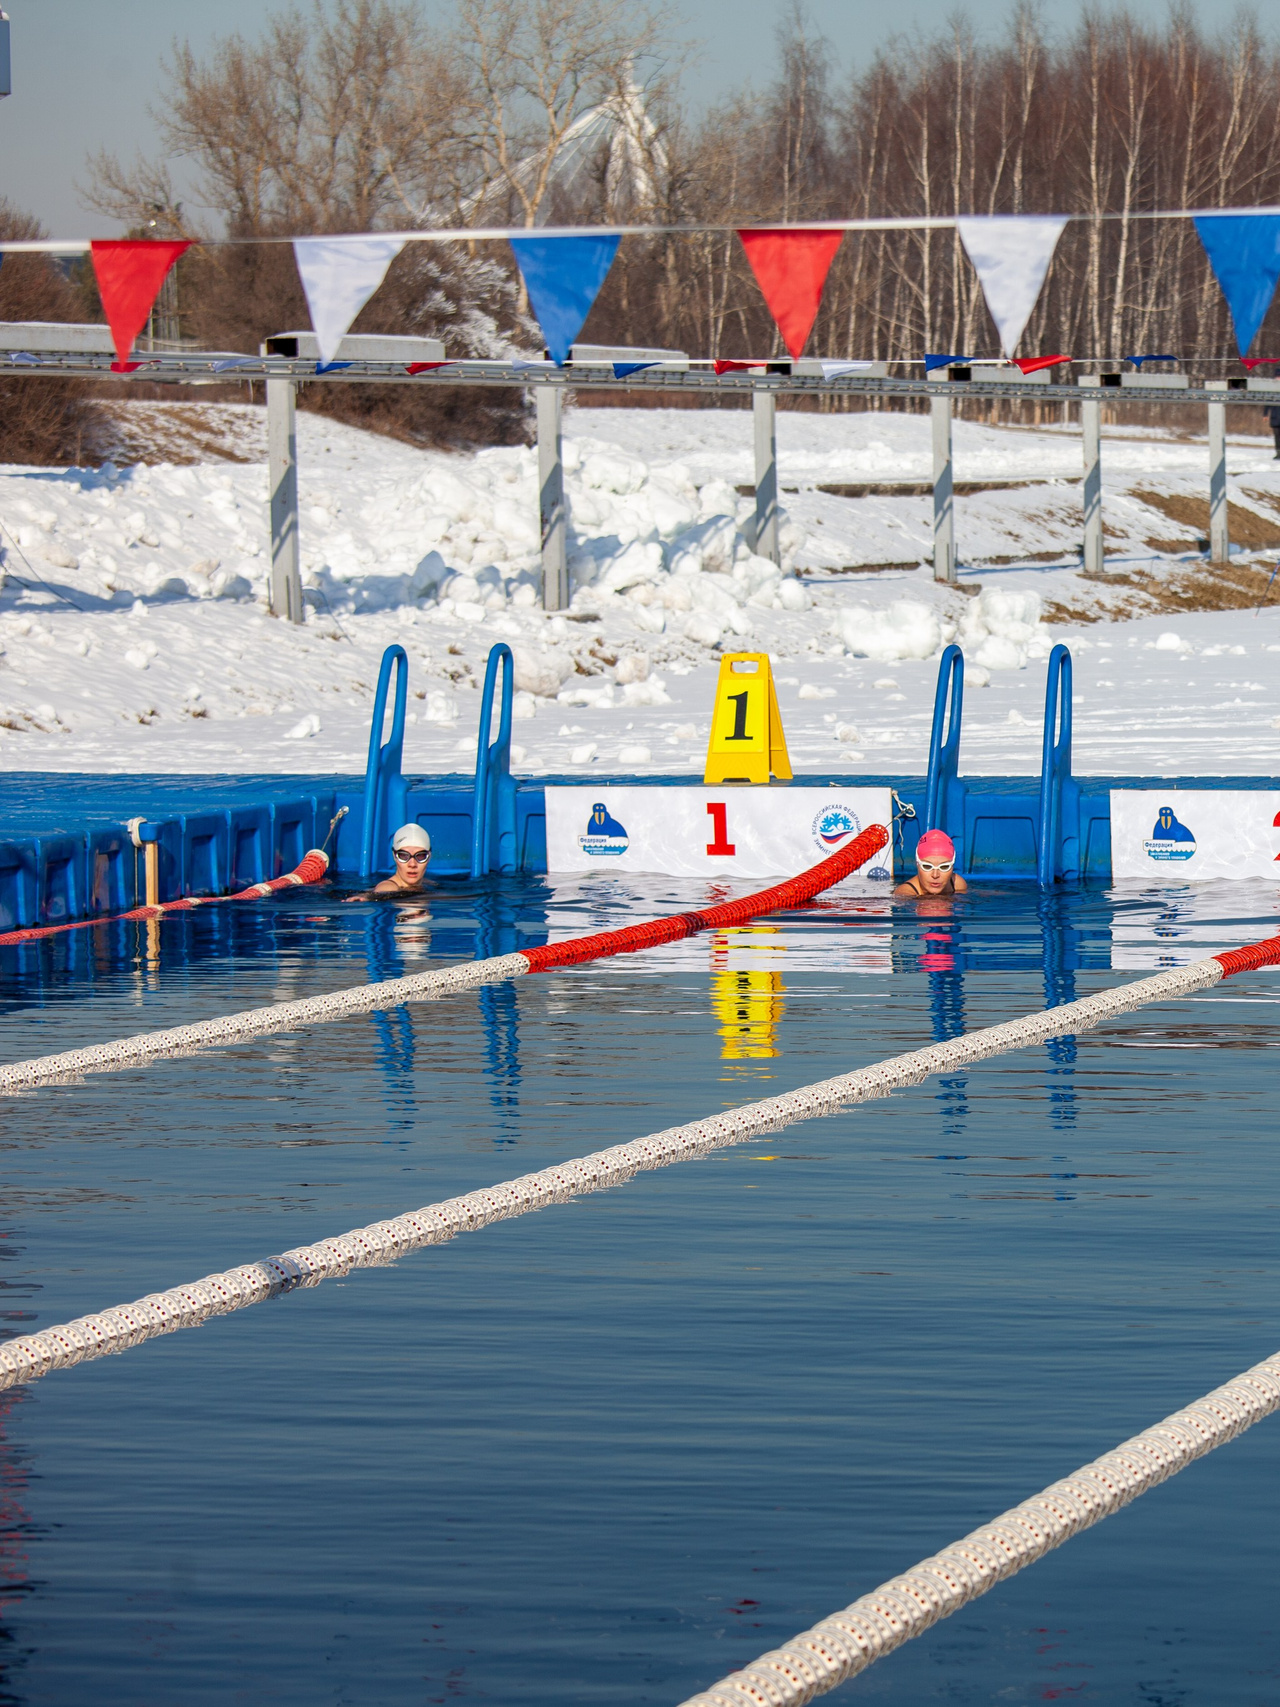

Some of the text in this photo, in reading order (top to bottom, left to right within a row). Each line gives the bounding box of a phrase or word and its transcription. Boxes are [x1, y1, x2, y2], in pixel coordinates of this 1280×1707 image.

[725, 691, 753, 740] 1
[706, 803, 736, 856] 1
[812, 804, 862, 835] ВСЕРОССИЙСКАЯ ФЕДЕРАЦИ
